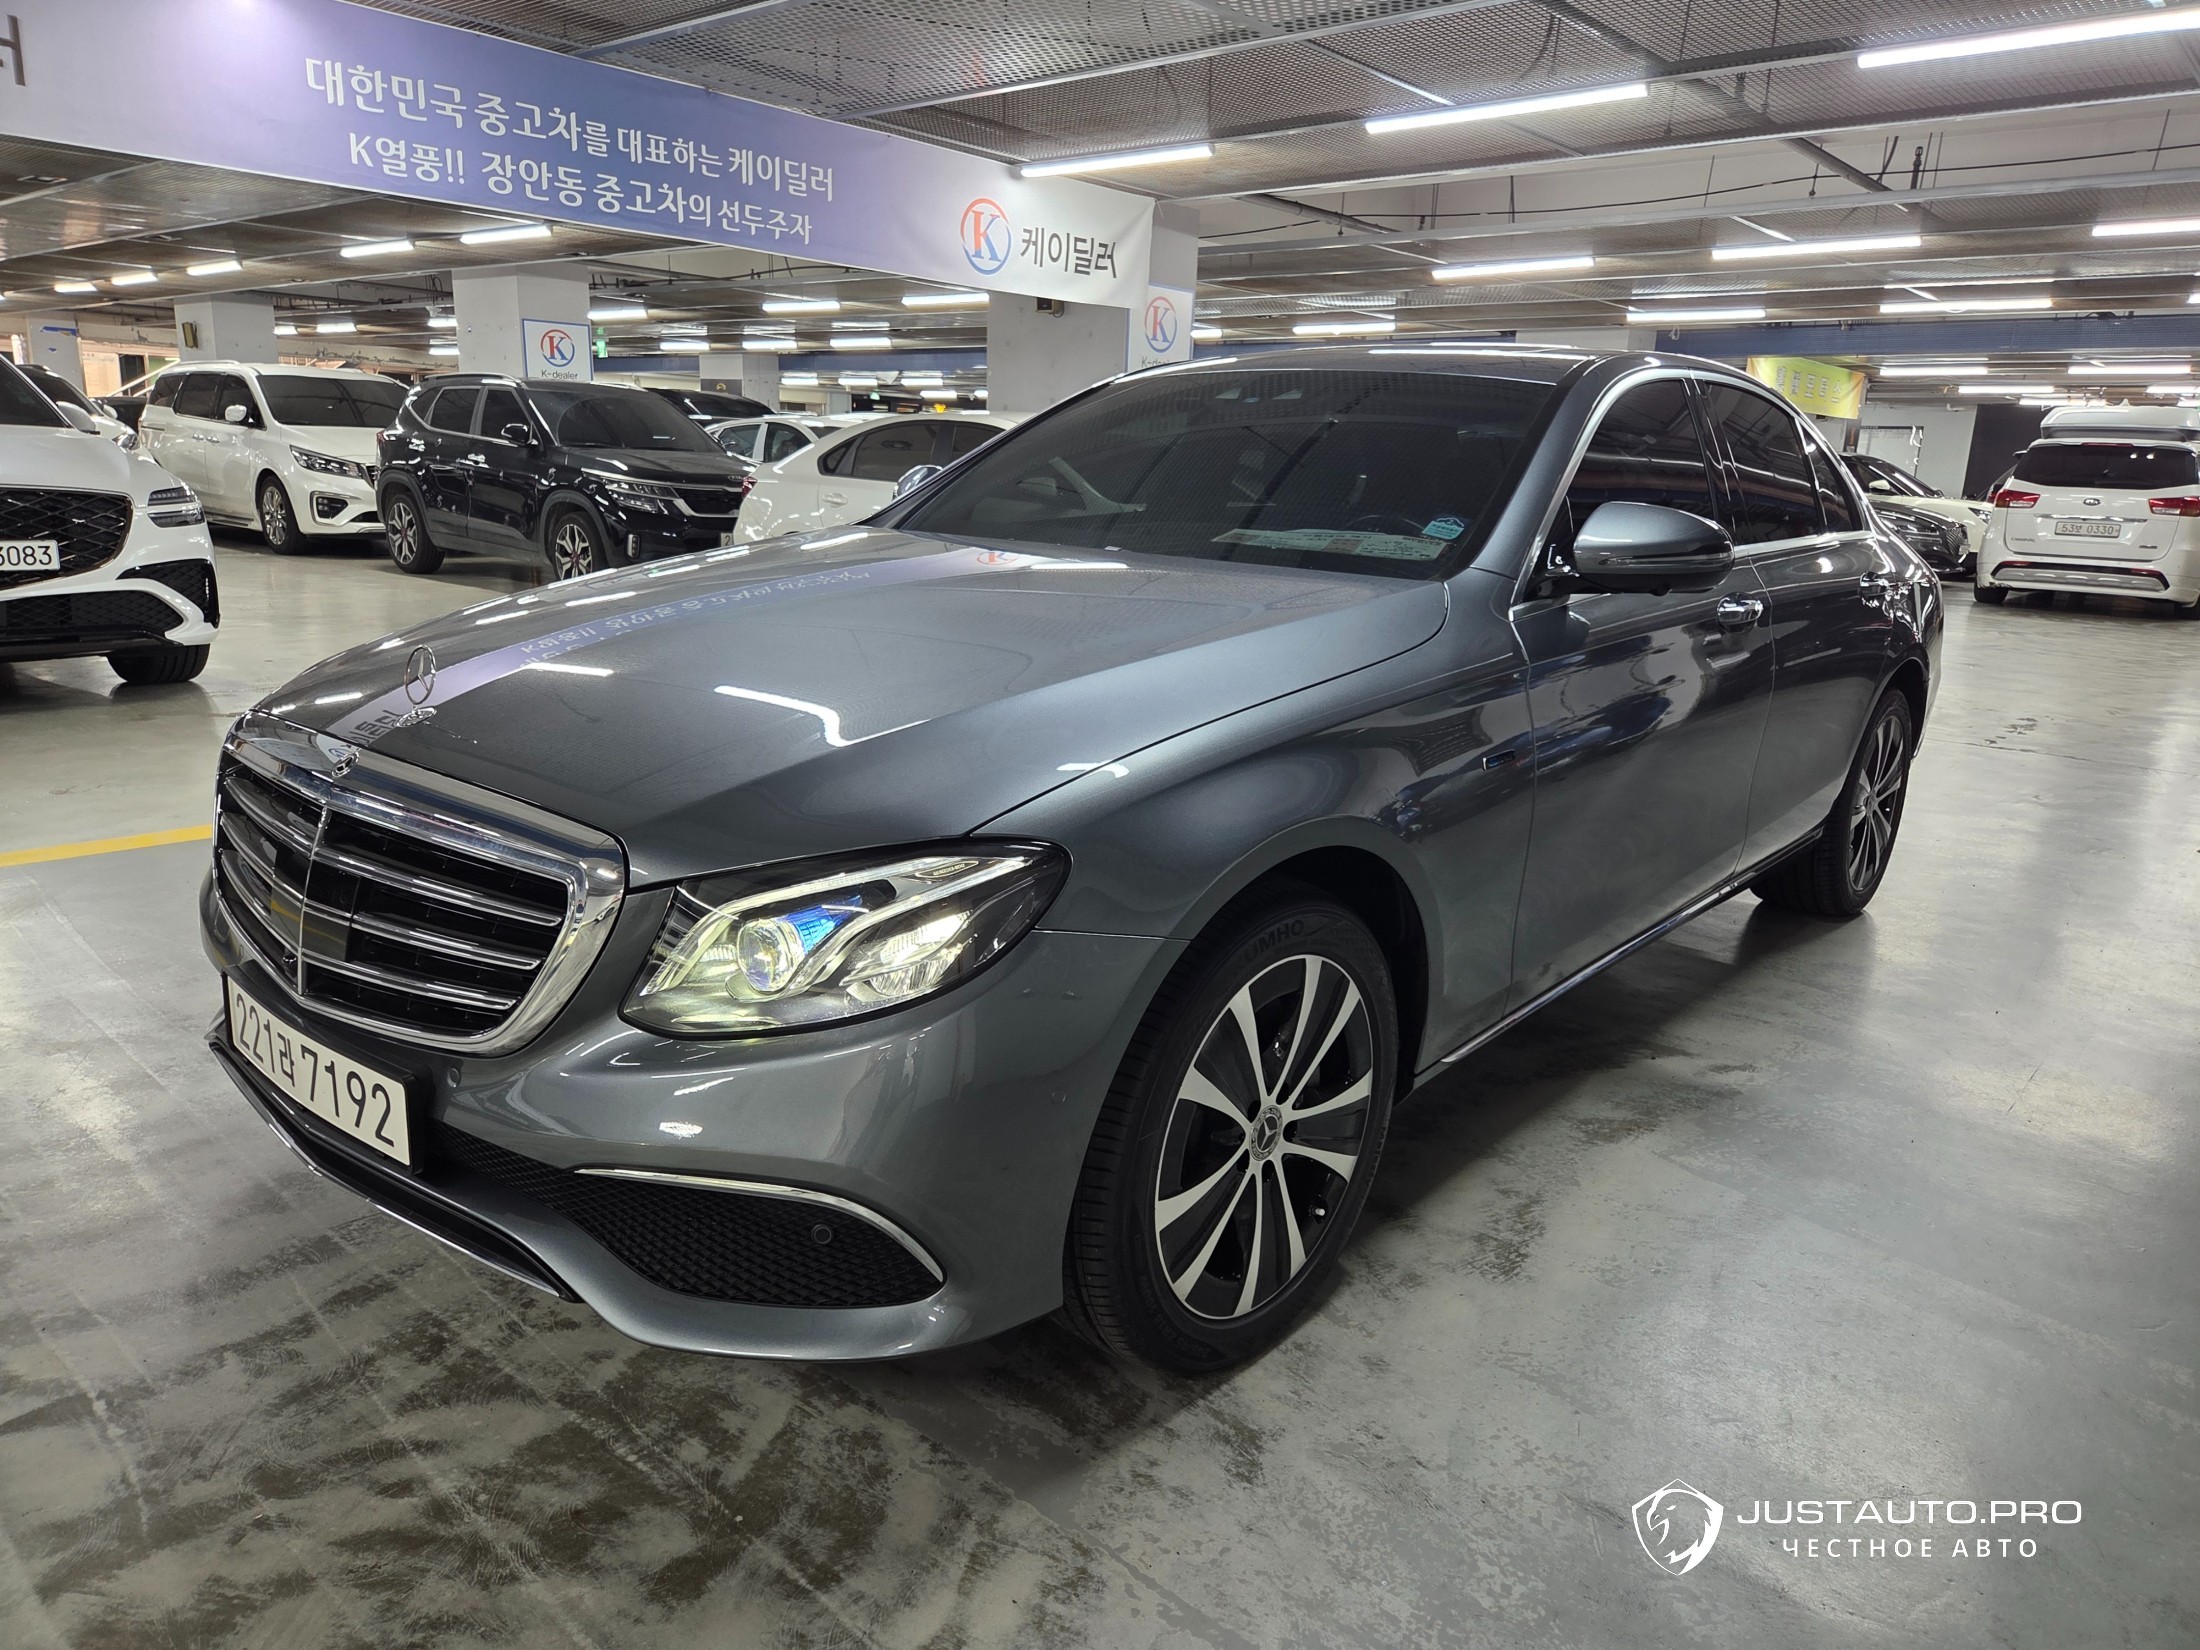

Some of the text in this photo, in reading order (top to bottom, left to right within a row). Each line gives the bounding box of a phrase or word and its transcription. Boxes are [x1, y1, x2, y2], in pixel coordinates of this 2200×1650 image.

[304, 57, 833, 202] 대한민국 중고차를 대표하는 케이딜러
[349, 132, 813, 245] K열풍!! 장안동 중고차의 선두주자
[1020, 226, 1118, 279] 케이딜러
[541, 369, 579, 380] K-dealer
